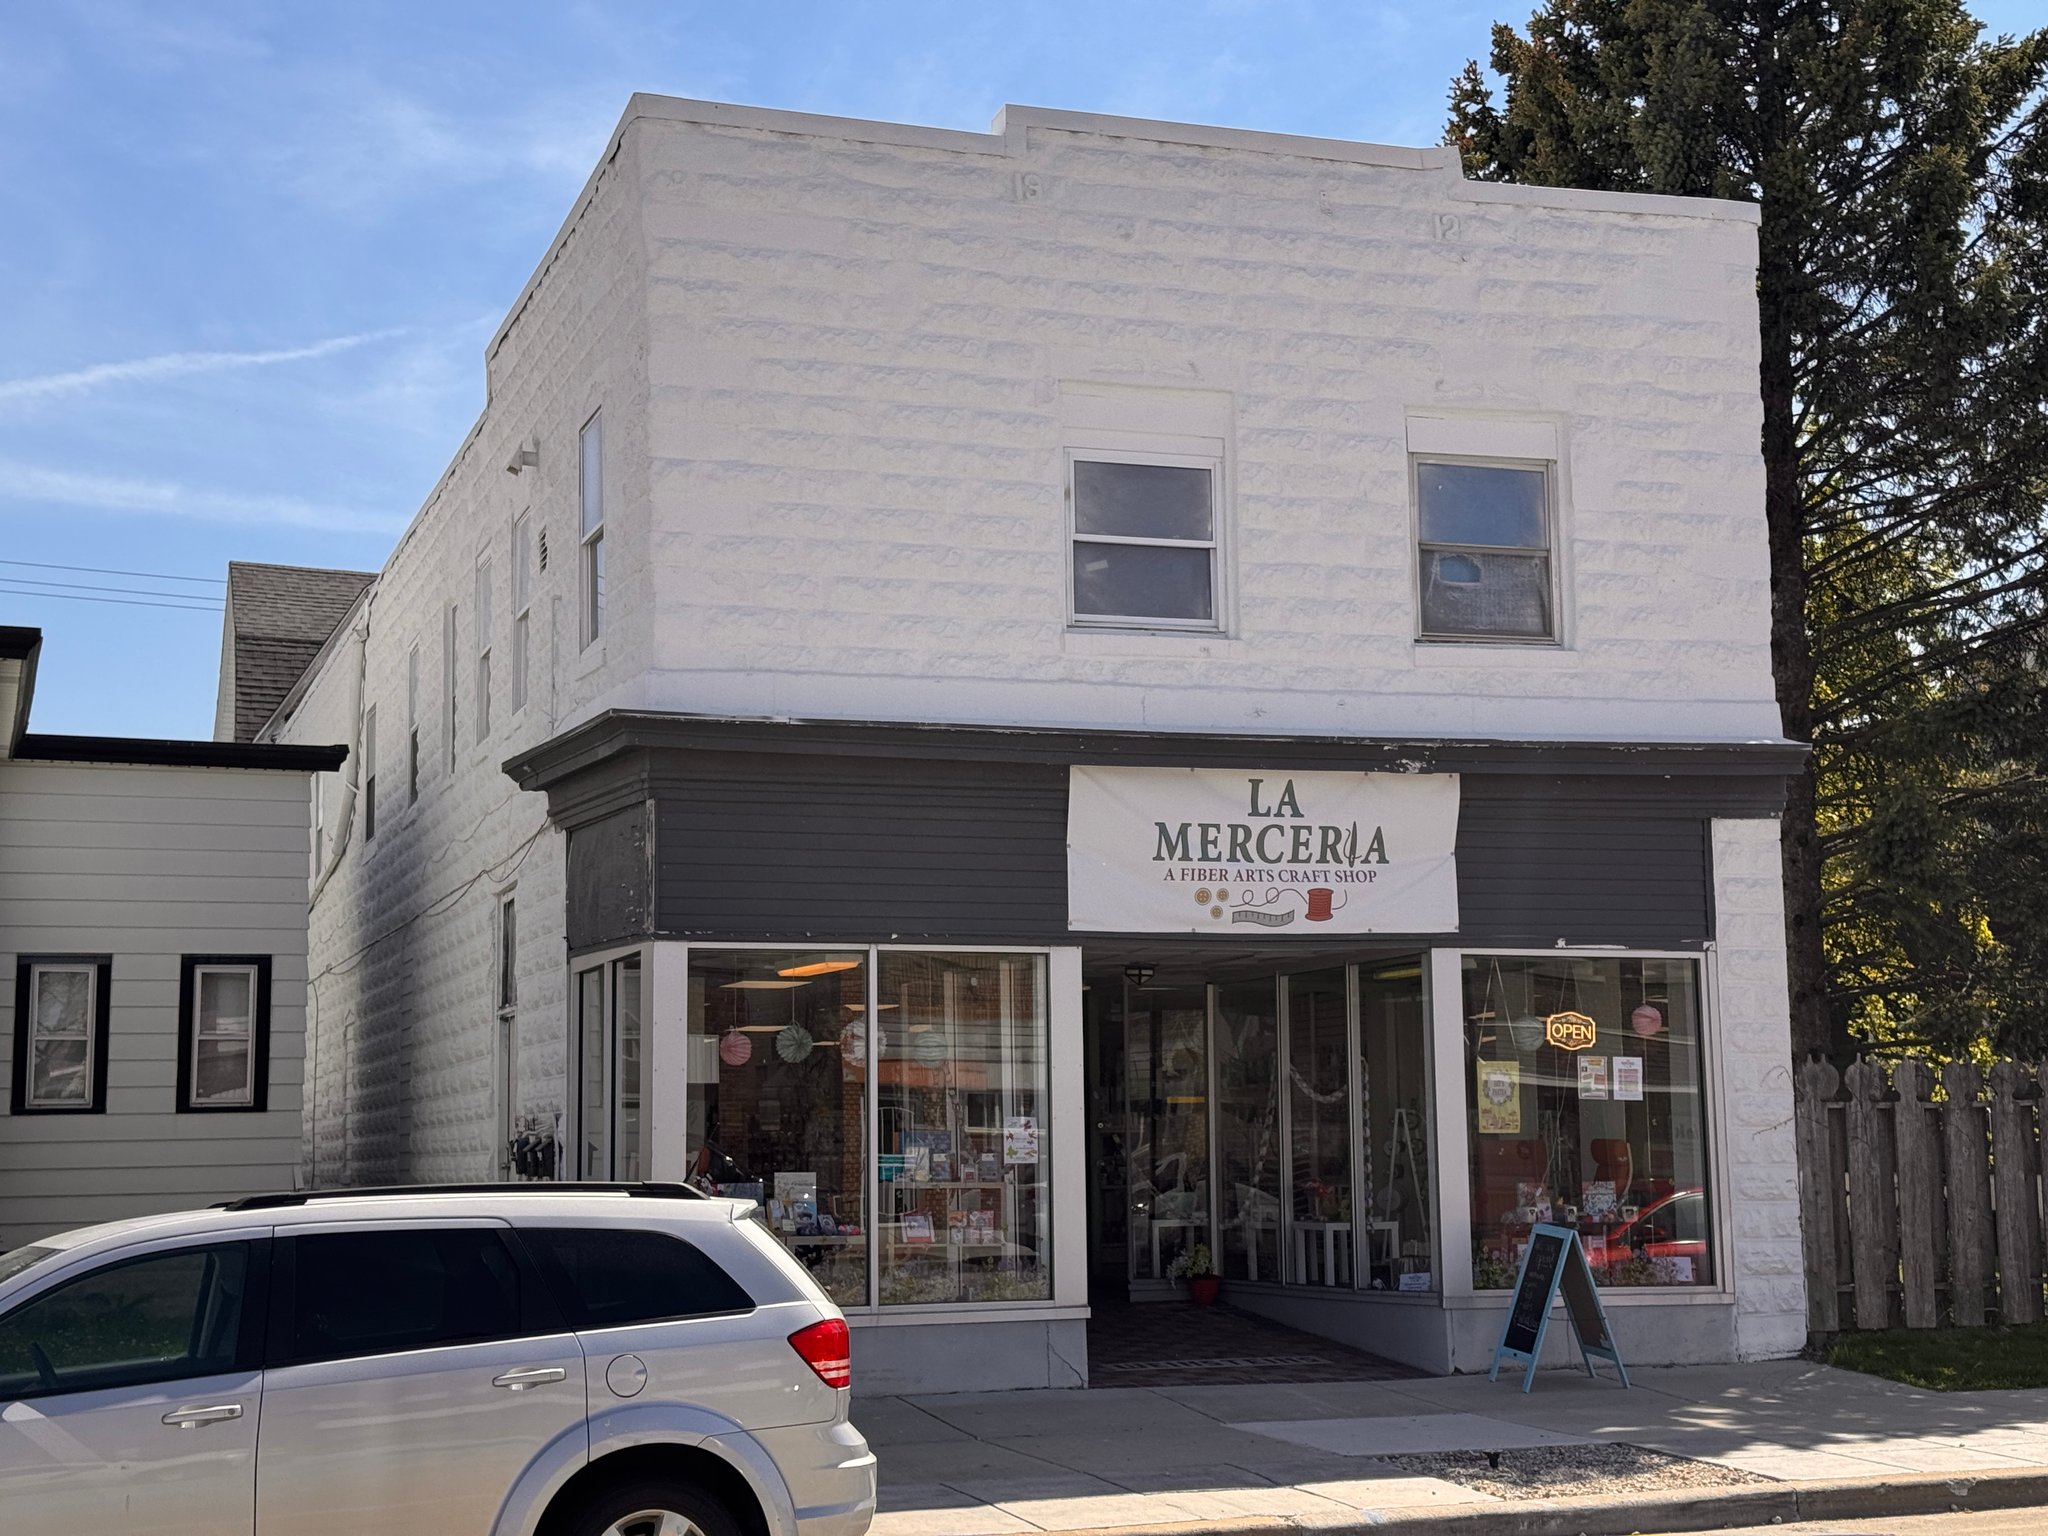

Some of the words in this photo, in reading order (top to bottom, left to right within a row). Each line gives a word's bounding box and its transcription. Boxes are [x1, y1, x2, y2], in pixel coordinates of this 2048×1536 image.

[1433, 213, 1461, 240] 12
[1247, 778, 1304, 818] LA
[1152, 821, 1390, 868] MERCERIA
[1163, 867, 1175, 881] A
[1180, 867, 1229, 882] FIBER
[1233, 868, 1275, 882] ARTS
[1278, 868, 1331, 883] CRAFT
[1334, 869, 1377, 883] SHOP
[1551, 1023, 1592, 1040] OPEN
